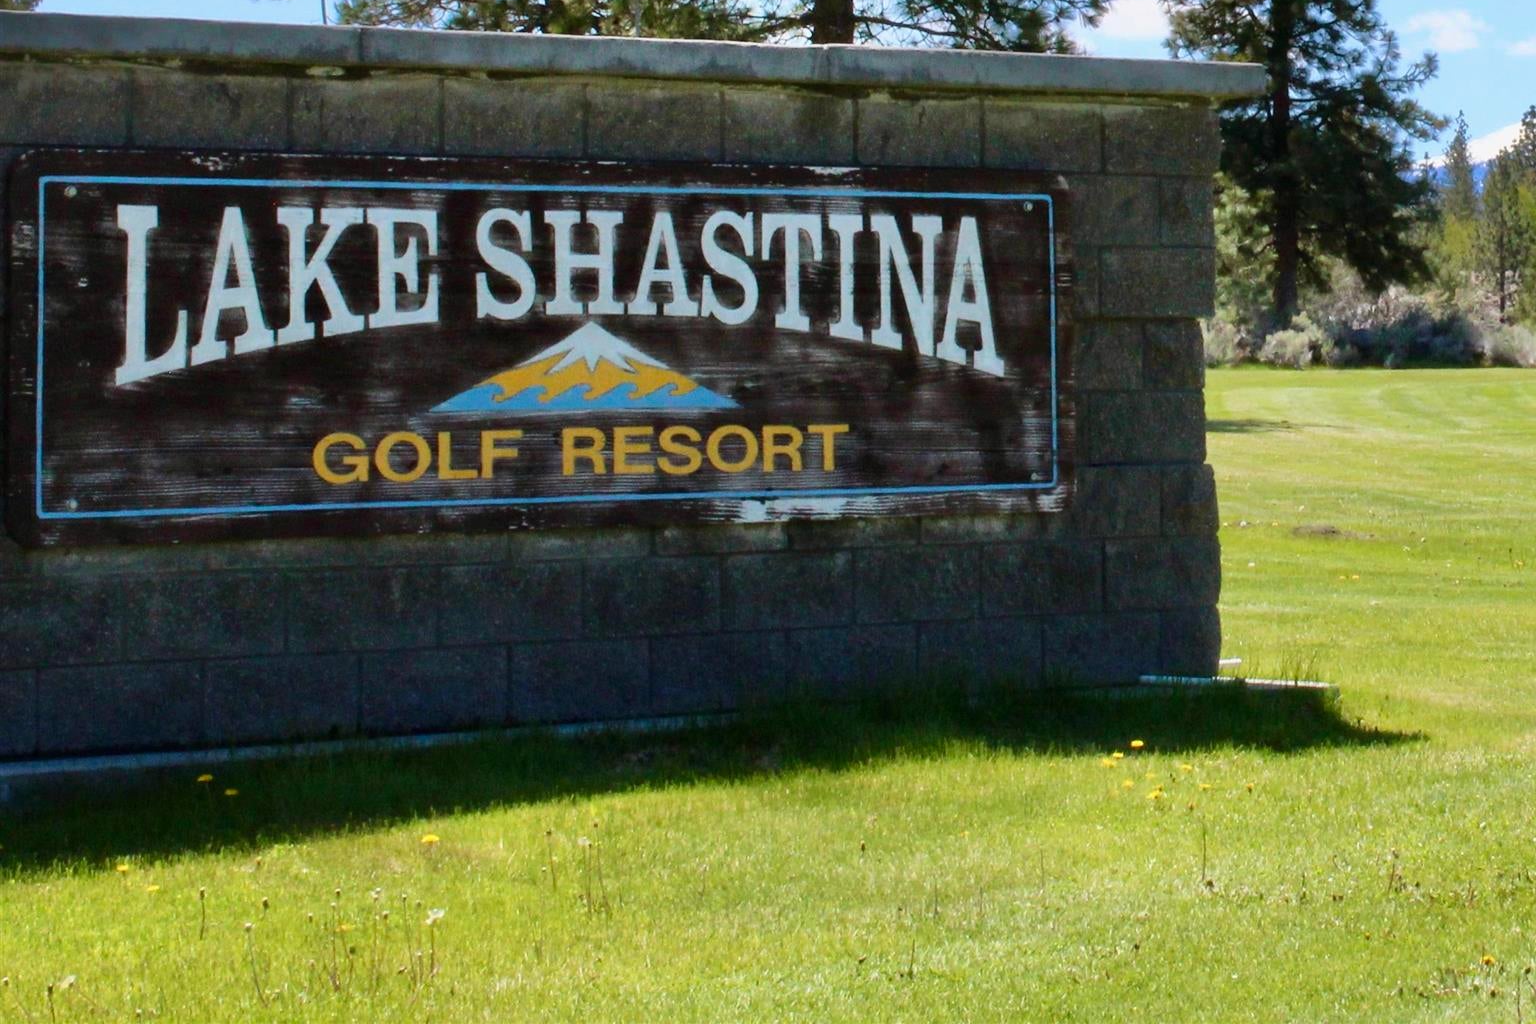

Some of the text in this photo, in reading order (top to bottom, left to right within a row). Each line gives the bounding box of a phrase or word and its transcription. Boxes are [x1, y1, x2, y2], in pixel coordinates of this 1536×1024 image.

[114, 202, 1006, 387] LAKE SHASTINA
[311, 422, 851, 486] GOLF RESORT
